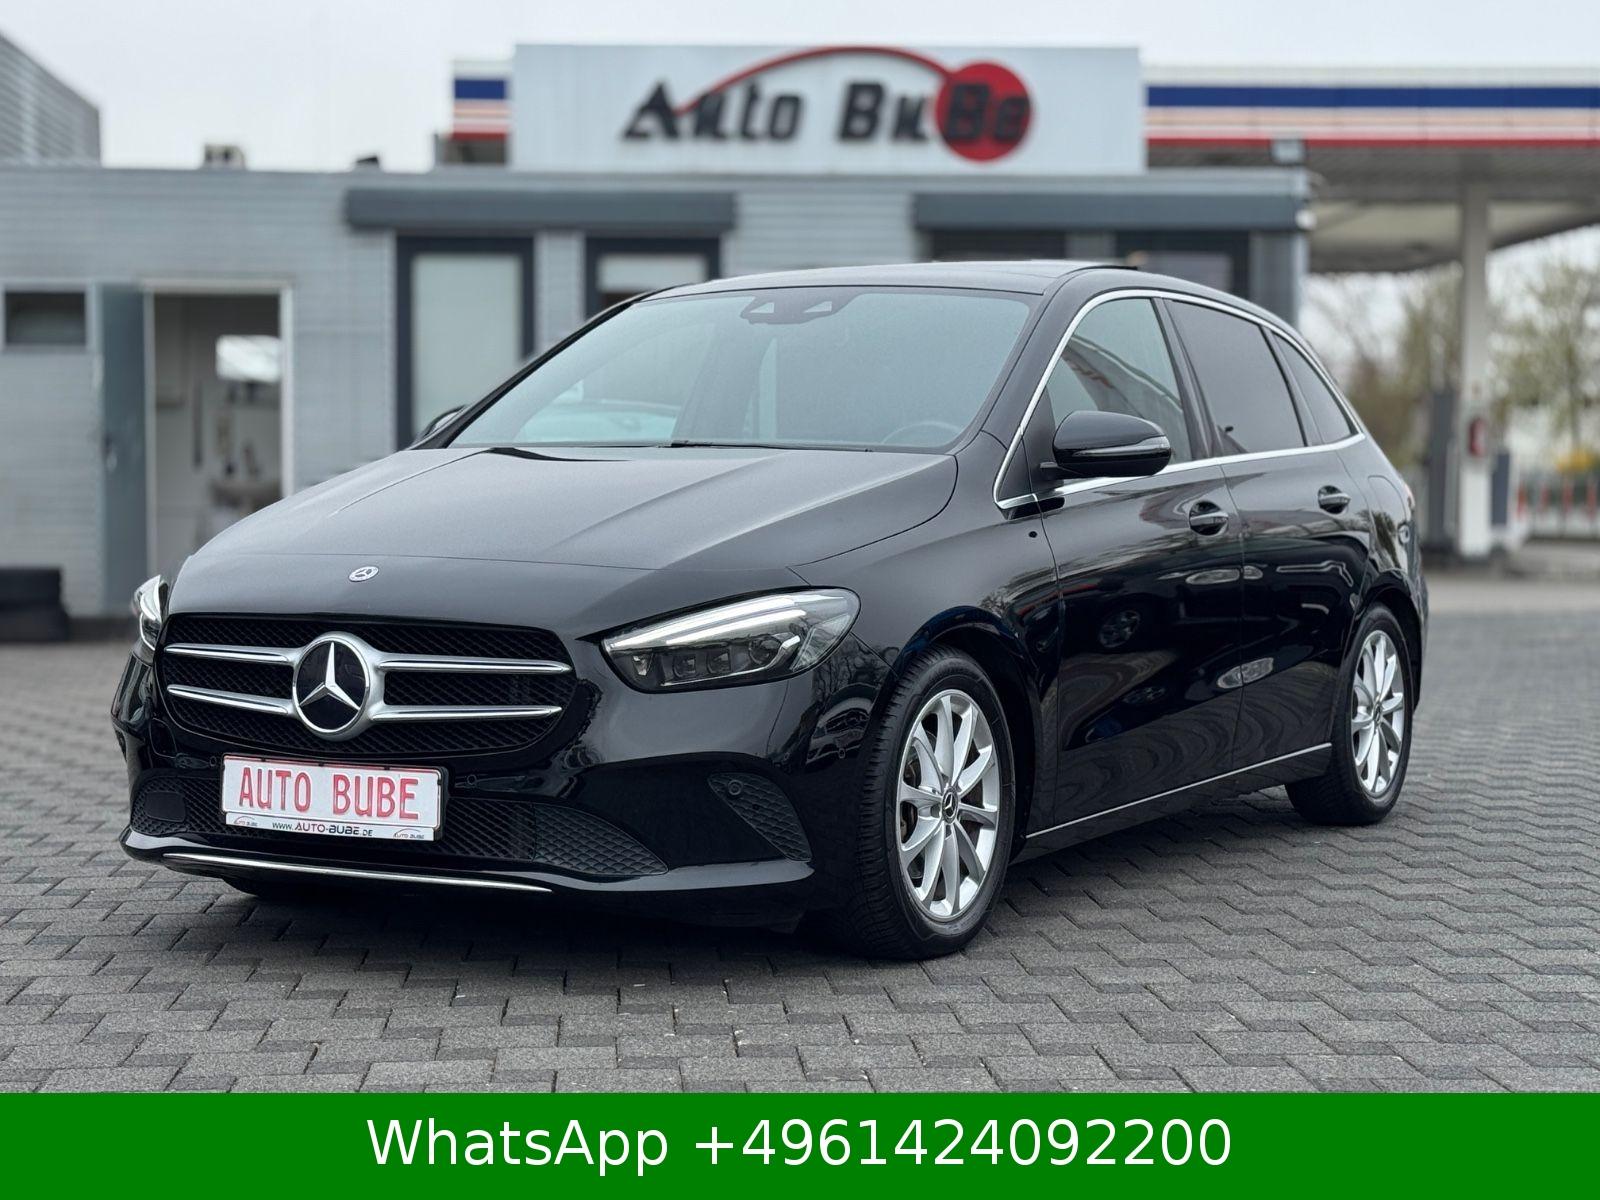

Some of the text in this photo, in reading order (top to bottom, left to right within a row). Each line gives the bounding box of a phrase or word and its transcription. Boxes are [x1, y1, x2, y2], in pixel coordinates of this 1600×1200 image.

[622, 79, 804, 141] Auto
[239, 766, 419, 820] AUTO BUBE
